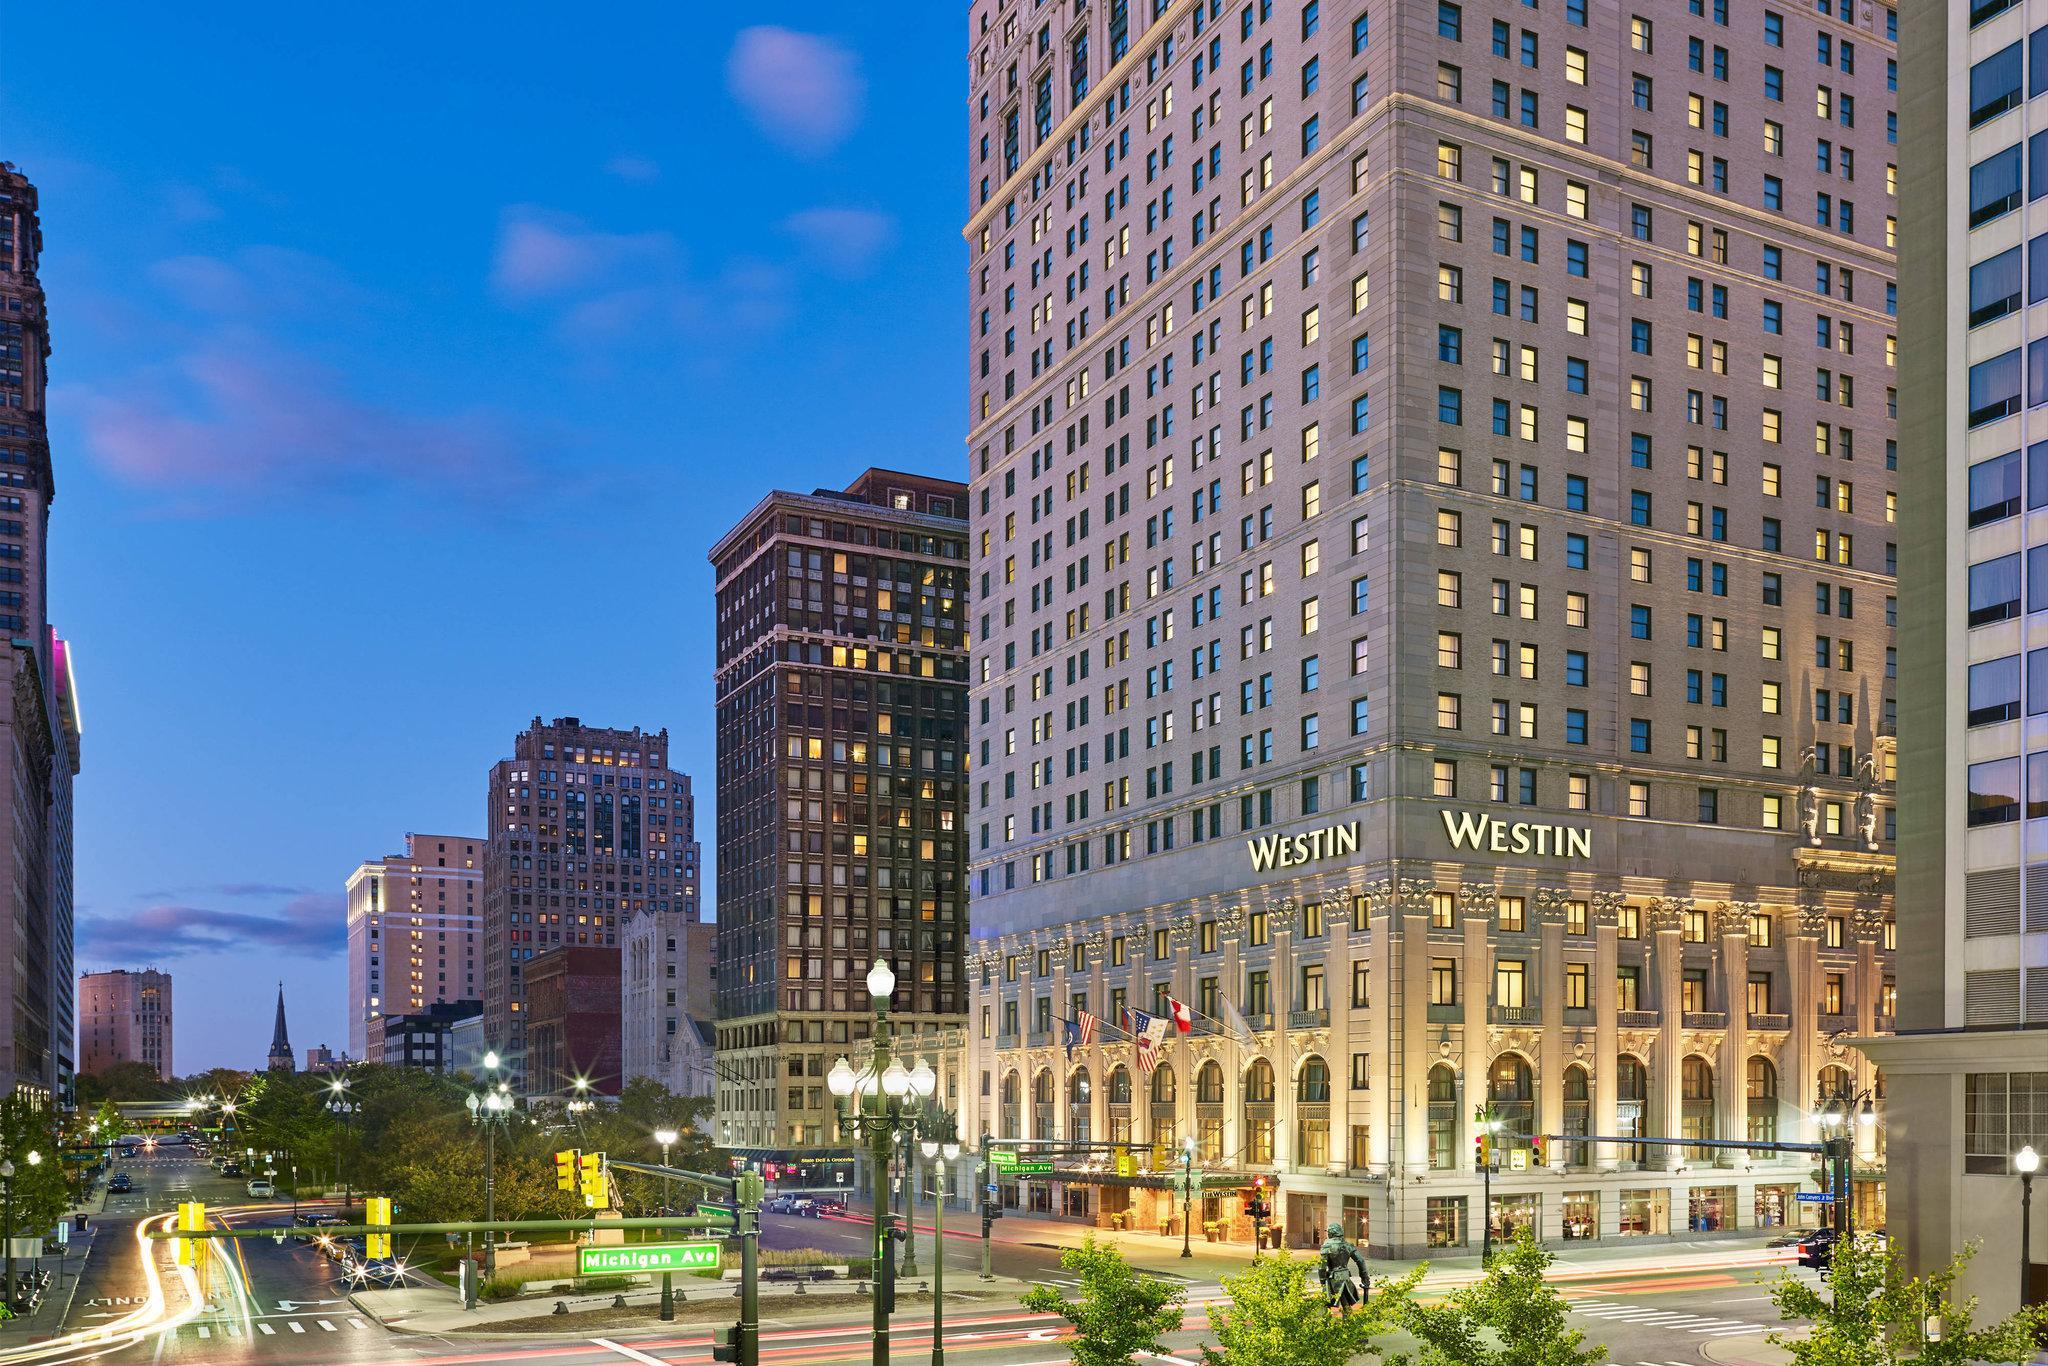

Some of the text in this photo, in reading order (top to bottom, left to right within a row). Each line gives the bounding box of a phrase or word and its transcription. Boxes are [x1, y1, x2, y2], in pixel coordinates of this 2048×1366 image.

[1247, 820, 1361, 872] WESTIN
[1439, 809, 1592, 859] WESTIN
[585, 1250, 716, 1269] Michigan Ave
